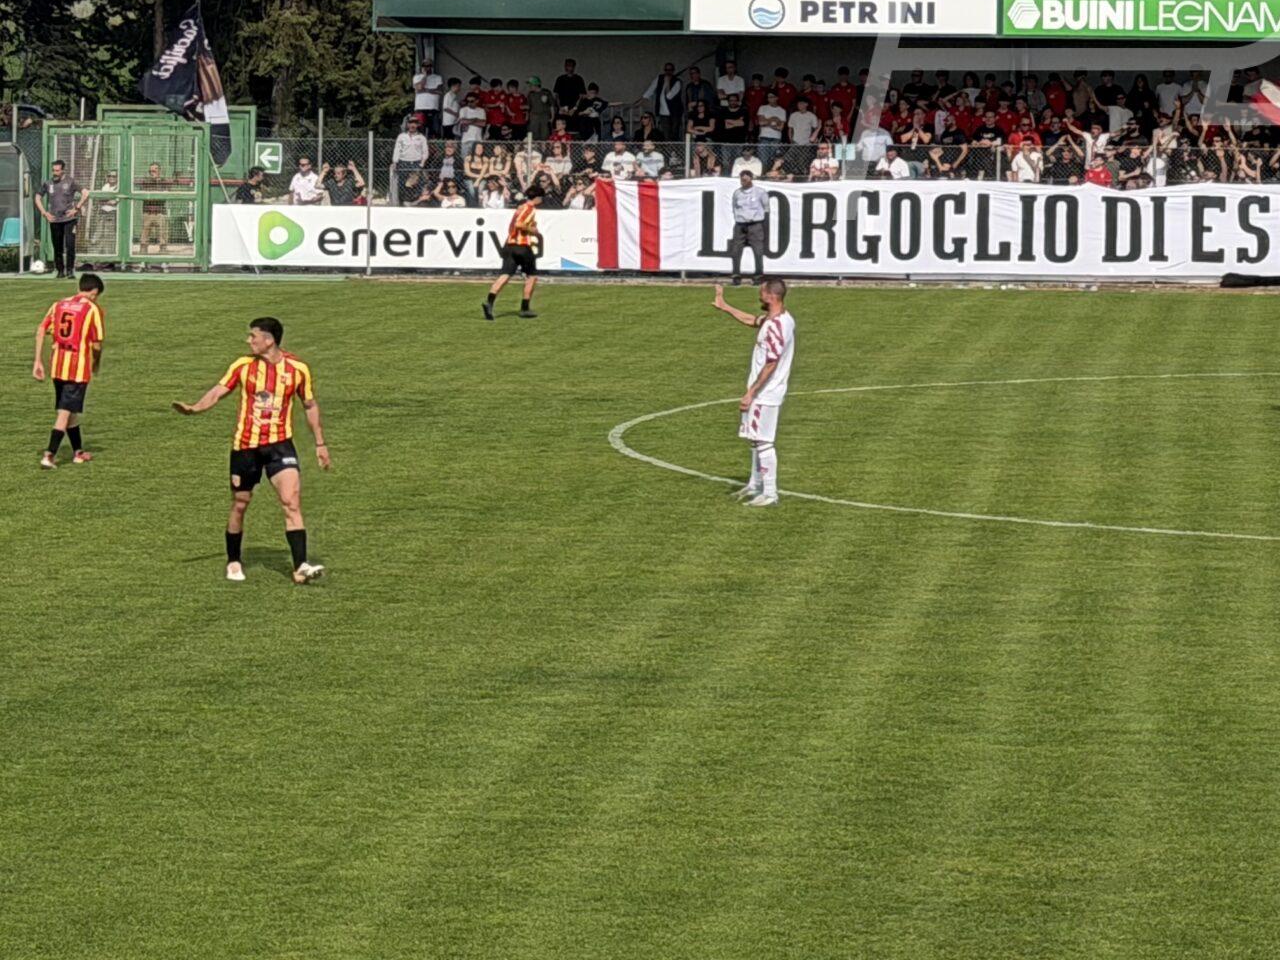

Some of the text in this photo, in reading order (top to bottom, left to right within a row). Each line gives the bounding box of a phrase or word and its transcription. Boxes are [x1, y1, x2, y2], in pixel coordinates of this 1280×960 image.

[799, 0, 935, 24] PETRINI
[1101, 196, 1169, 263] DI
[60, 311, 75, 338] 5
